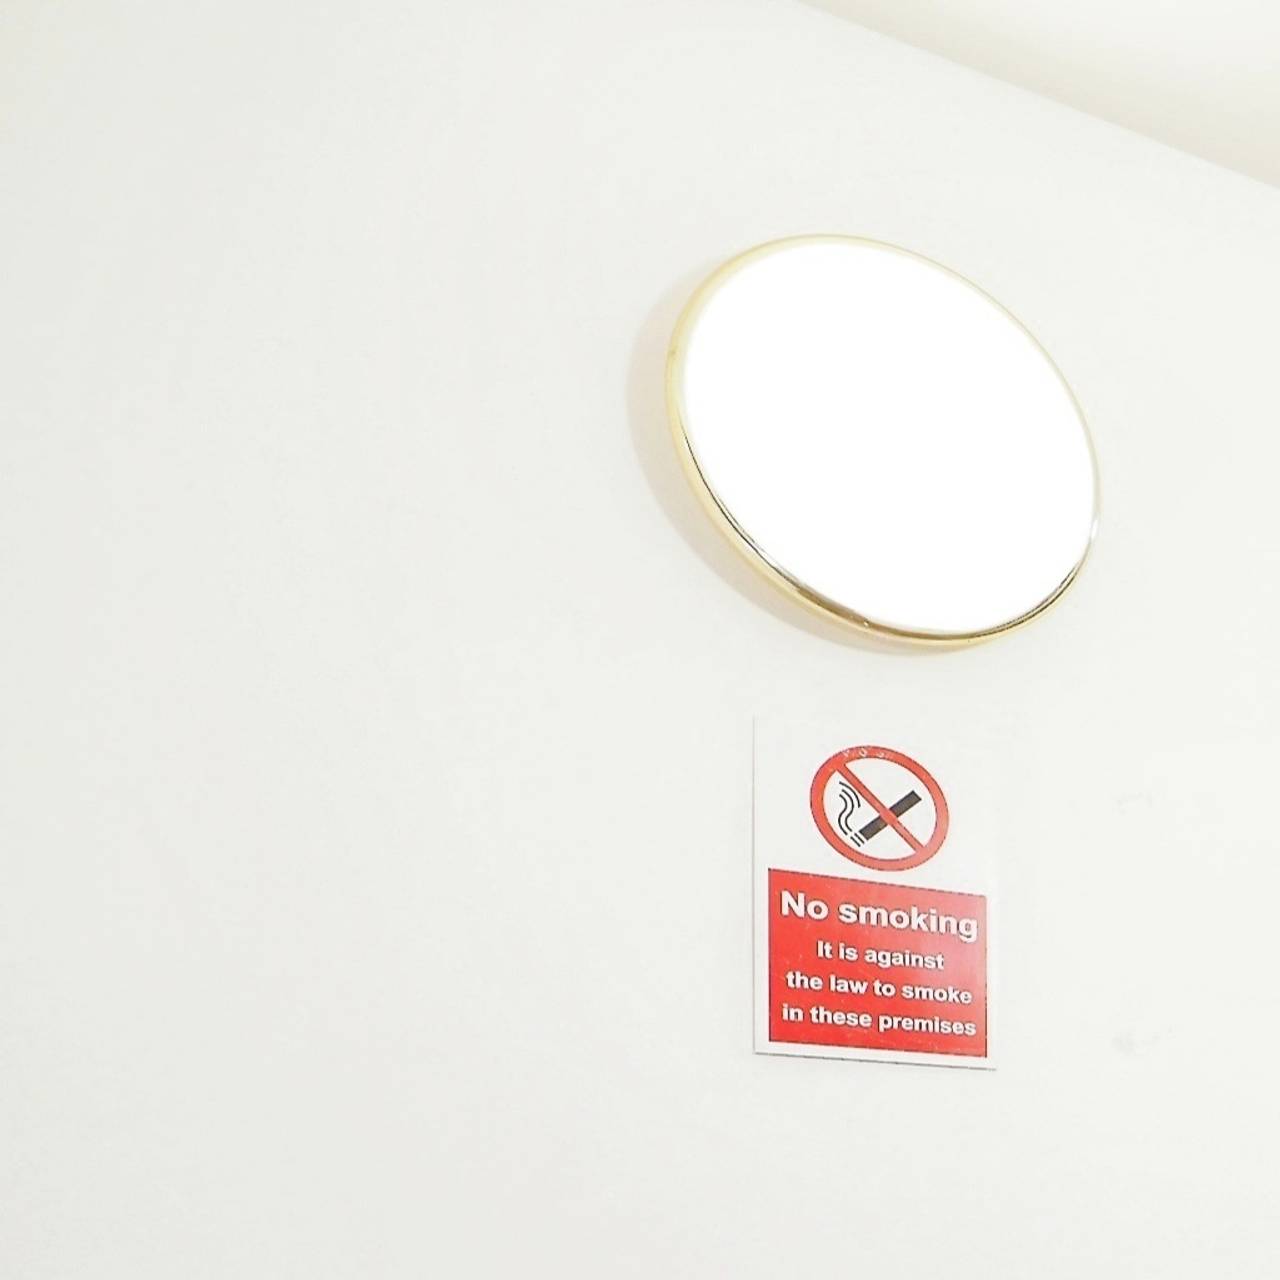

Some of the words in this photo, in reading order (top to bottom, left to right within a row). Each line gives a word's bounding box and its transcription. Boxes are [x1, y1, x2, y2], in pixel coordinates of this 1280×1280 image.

[780, 890, 829, 920] No
[838, 903, 978, 943] smoking
[817, 940, 833, 959] It
[839, 943, 858, 961] is
[864, 949, 945, 970] against
[786, 971, 823, 991] the
[829, 974, 868, 995] law
[873, 978, 896, 997] to
[901, 984, 973, 1004] smoke
[782, 1003, 803, 1022] in
[809, 1006, 872, 1028] these
[878, 1012, 977, 1036] premises
